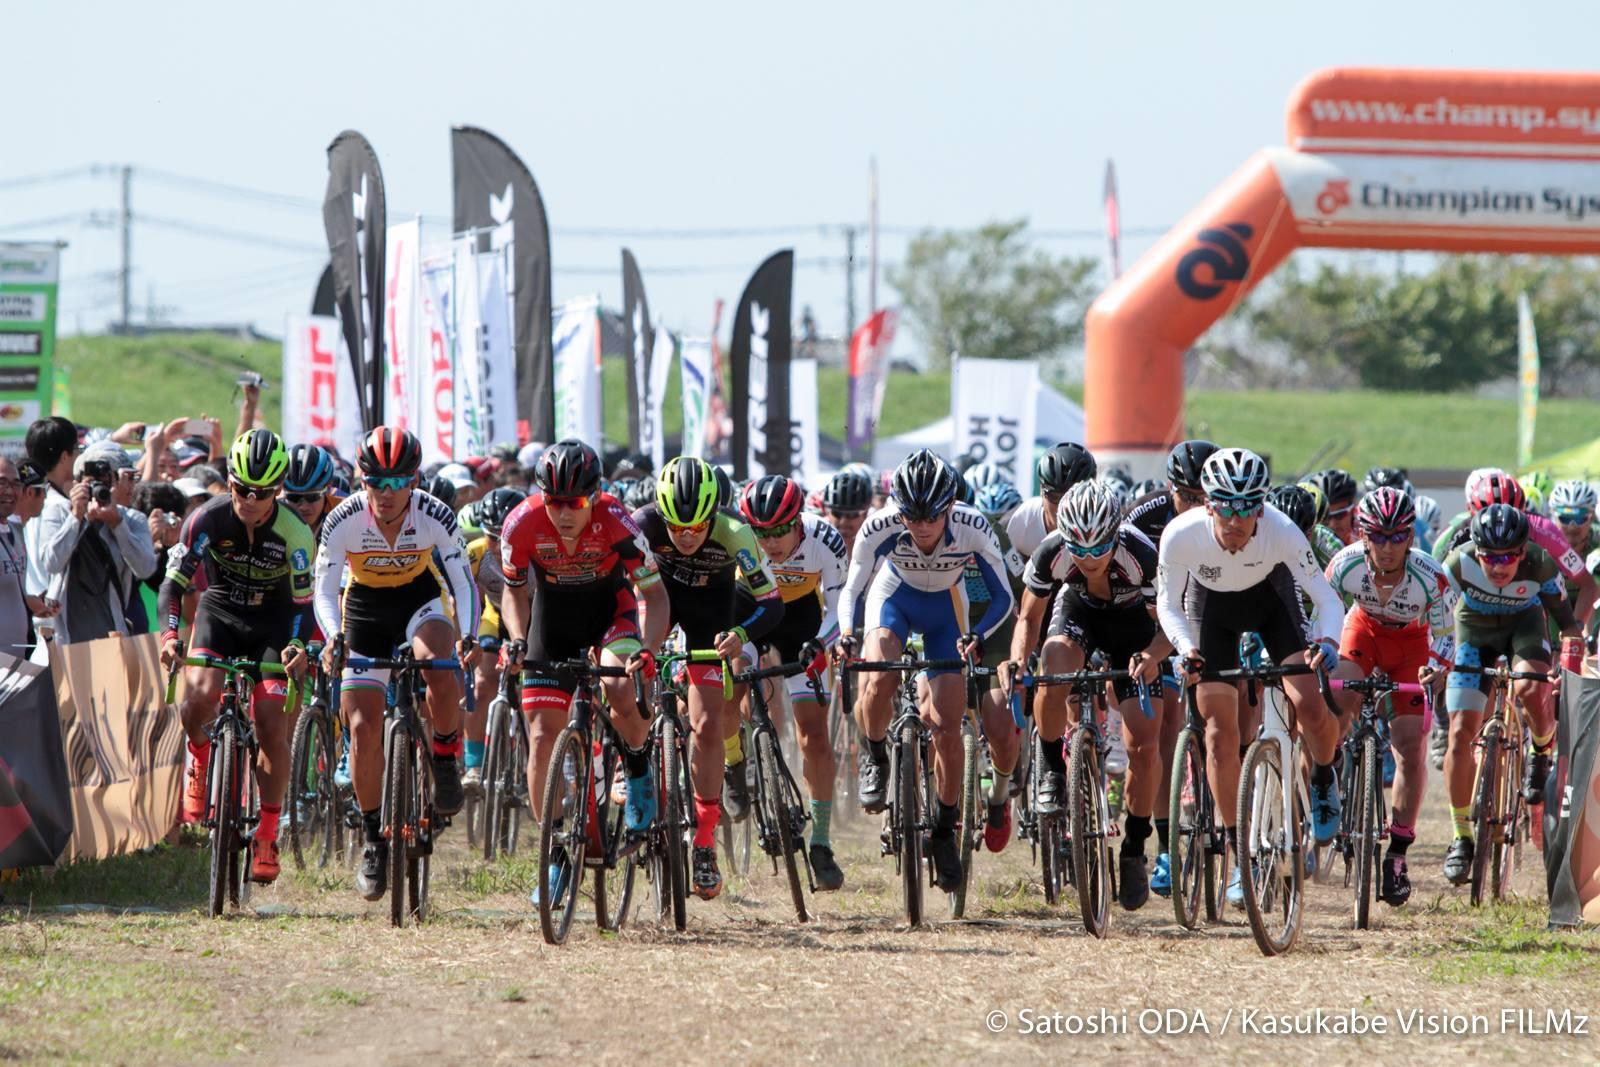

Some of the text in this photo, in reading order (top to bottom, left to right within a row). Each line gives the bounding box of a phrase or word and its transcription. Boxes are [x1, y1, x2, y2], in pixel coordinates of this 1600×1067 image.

[1361, 182, 1534, 217] Champion
[1124, 495, 1167, 523] HIMANO
[951, 510, 994, 538] cuor
[1563, 551, 1577, 568] 25
[523, 678, 559, 687] HIMANO
